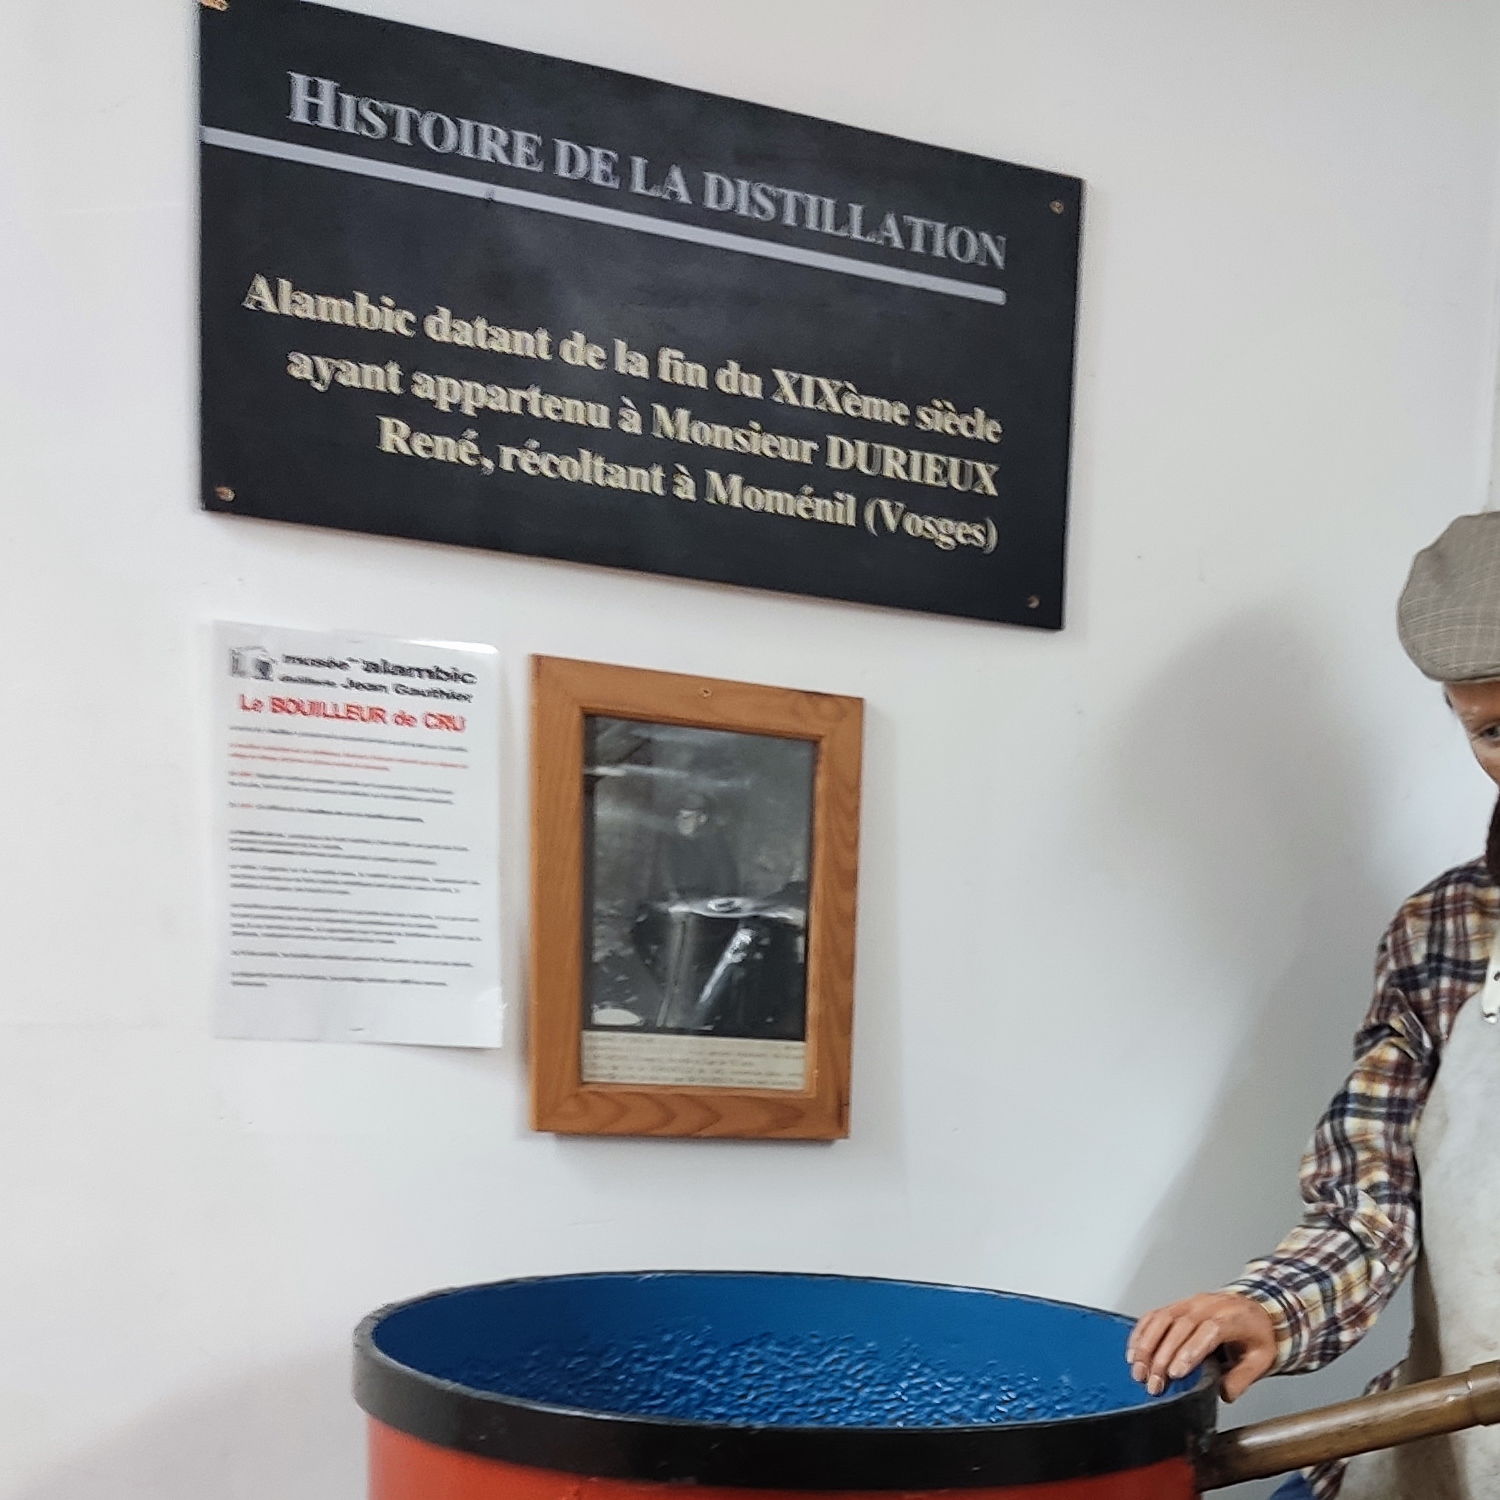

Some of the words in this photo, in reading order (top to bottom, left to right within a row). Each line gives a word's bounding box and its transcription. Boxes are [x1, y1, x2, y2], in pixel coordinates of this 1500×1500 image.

[286, 71, 544, 172] HISTOIRE
[552, 138, 621, 189] DE
[629, 155, 693, 204] LA
[702, 170, 1007, 270] DISTILLATION
[241, 272, 417, 337] Alambic
[423, 305, 553, 361] datant
[559, 330, 608, 370] de
[613, 337, 650, 380] la
[657, 346, 709, 390] fin
[715, 359, 764, 400] du
[770, 368, 911, 427] XIXème
[914, 397, 1003, 444] siècle
[286, 351, 404, 393] ayant
[411, 371, 613, 430] appartenu
[617, 395, 643, 436] à
[650, 402, 820, 465] Monsieur
[825, 434, 1000, 497] DURIEUX
[376, 414, 495, 476] René,
[496, 438, 667, 497] récoltant
[672, 462, 697, 502] à
[703, 468, 857, 527] Moménil
[863, 498, 999, 555] (Vosges)
[268, 694, 388, 725] BOUILLEUR
